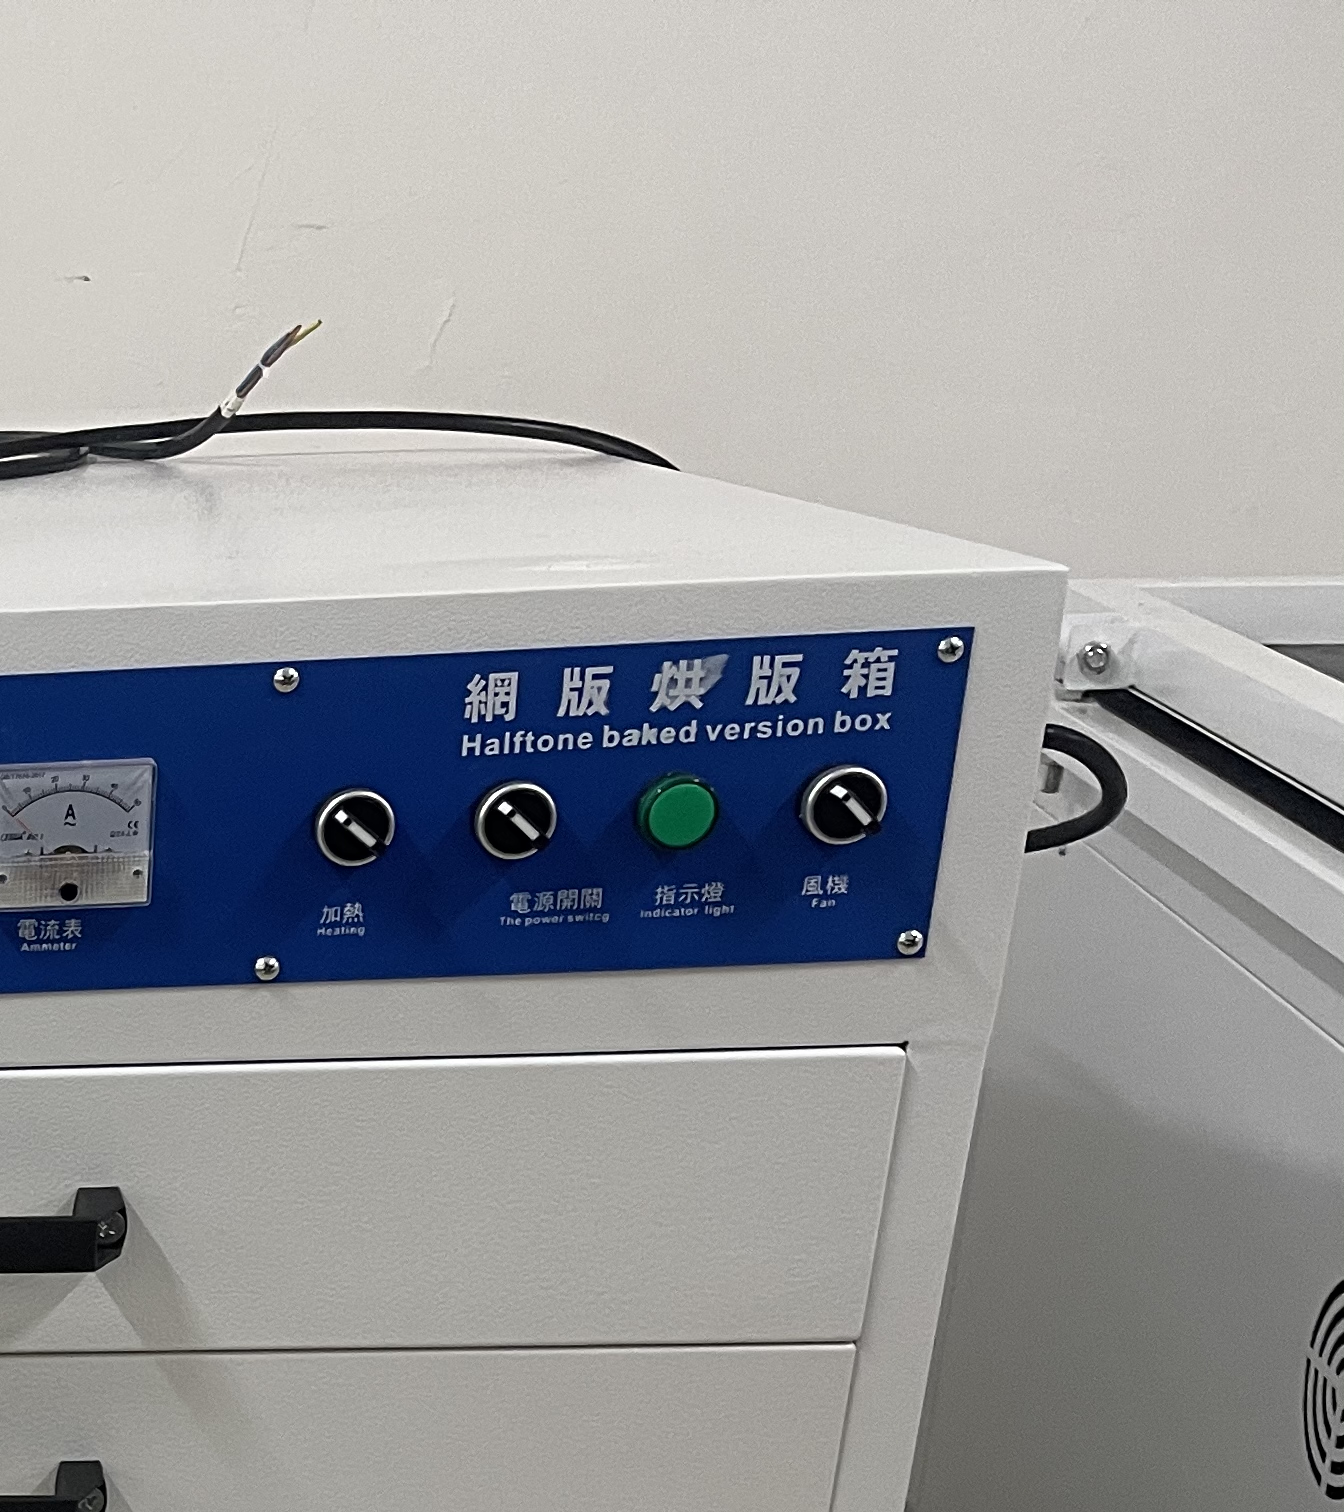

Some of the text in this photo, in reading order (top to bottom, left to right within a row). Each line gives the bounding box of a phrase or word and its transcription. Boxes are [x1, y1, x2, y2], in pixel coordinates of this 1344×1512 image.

[463, 647, 899, 724] 網版烘版箱
[460, 709, 892, 756] Halftone baked version box
[64, 803, 77, 821] A
[654, 881, 725, 906] 指示燈
[801, 874, 849, 896] 風機
[510, 887, 603, 914] 電源開關
[704, 904, 735, 917] light
[811, 898, 836, 908] Fan
[319, 902, 364, 925] 加熱
[500, 915, 522, 926] The
[524, 914, 564, 927] power
[17, 918, 82, 941] 電流表
[317, 925, 365, 937] Heating
[20, 941, 77, 952] Ammeter
